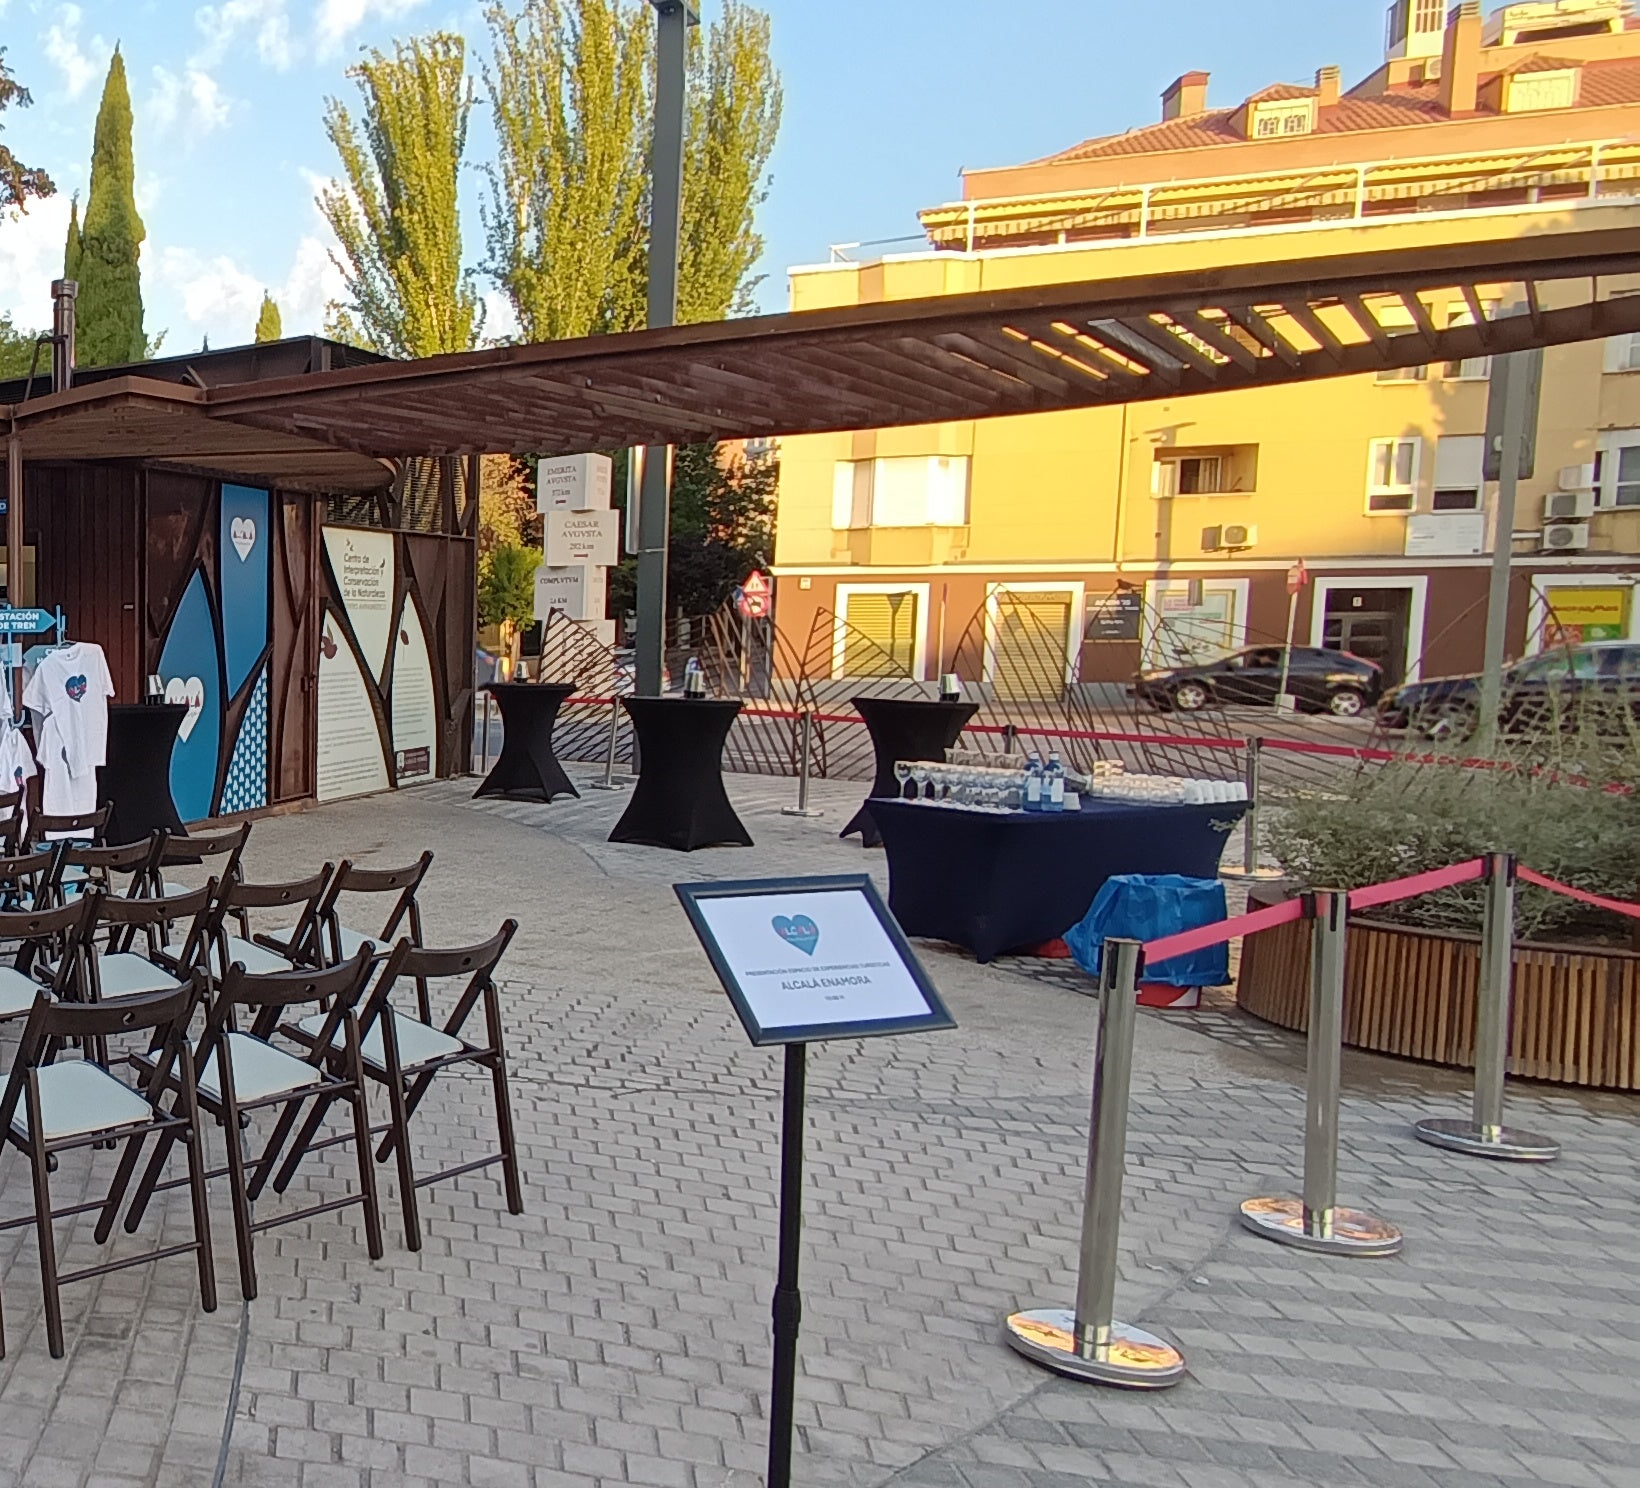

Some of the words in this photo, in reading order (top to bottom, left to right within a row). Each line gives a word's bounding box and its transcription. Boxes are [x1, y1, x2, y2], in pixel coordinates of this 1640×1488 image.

[564, 520, 599, 528] CAESAR
[561, 530, 603, 538] AVGVSTA
[343, 552, 362, 563] Centro
[11, 621, 36, 630] TREN
[781, 978, 821, 990] ALCALÁ
[821, 975, 872, 988] ENAMORA
